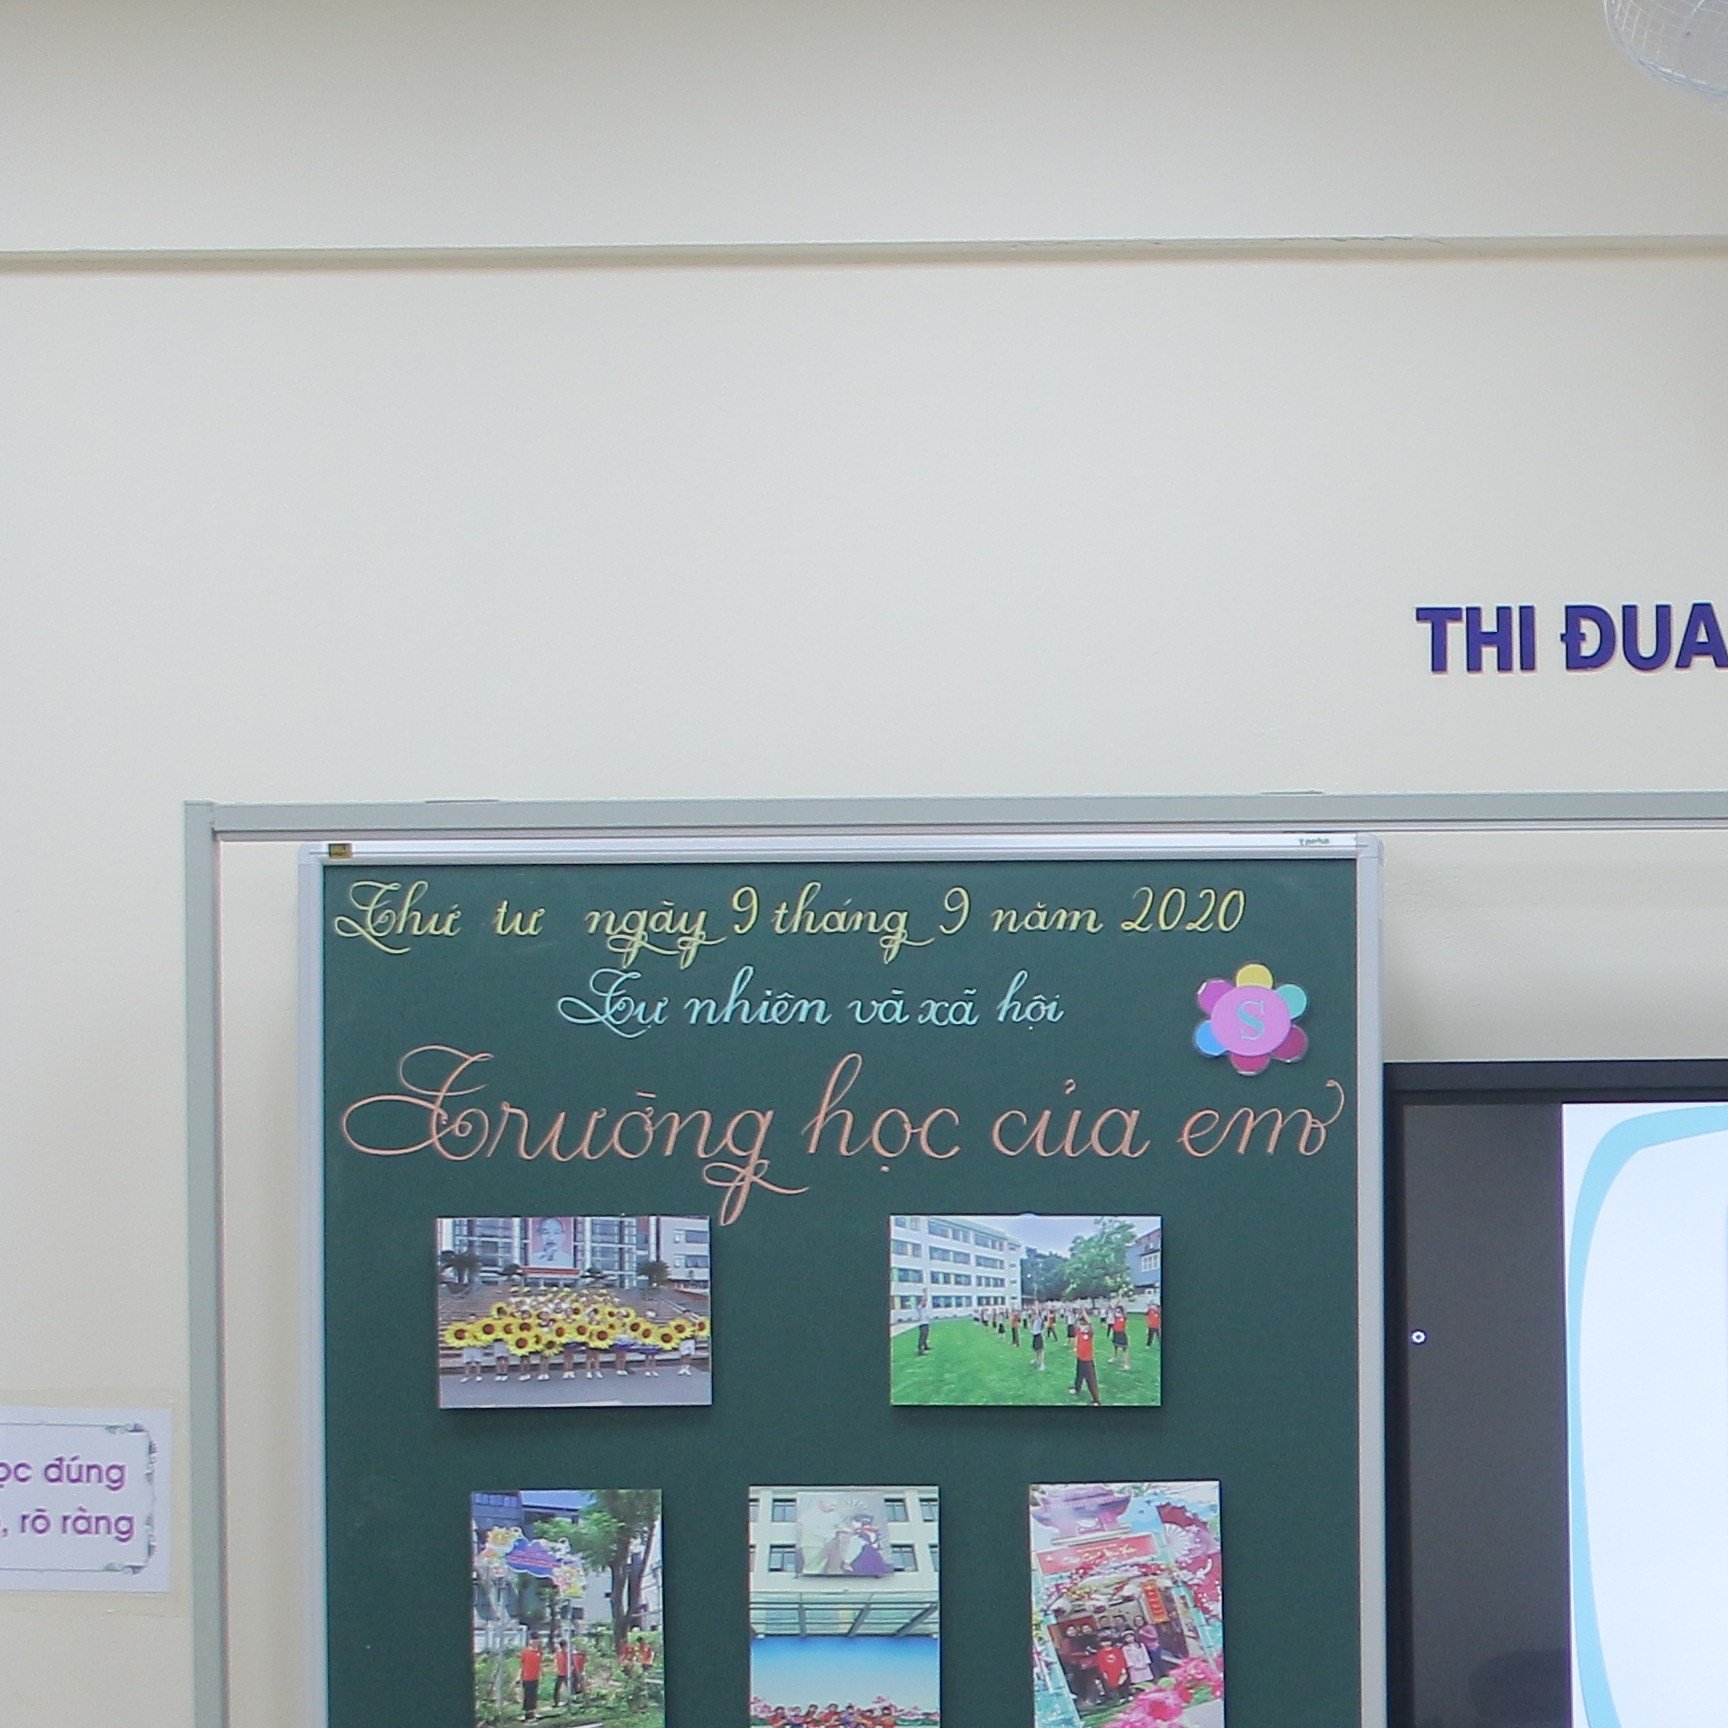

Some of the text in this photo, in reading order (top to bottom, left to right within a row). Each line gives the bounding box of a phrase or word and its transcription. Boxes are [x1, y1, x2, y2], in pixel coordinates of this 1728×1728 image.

[1416, 605, 1536, 674] THI
[335, 880, 1247, 970] Thứ tư ngày 9 tháng 9 năm 2020
[685, 965, 831, 1025] nhiên
[847, 990, 909, 1024] và
[917, 989, 979, 1026] xã
[998, 970, 1065, 1030] hội
[1238, 1001, 1266, 1041] S
[340, 1045, 810, 1227] Trường
[801, 1053, 963, 1172] học
[992, 1079, 1151, 1159] của
[43, 1455, 127, 1492] đúng
[20, 1506, 135, 1543] rõ ràng
